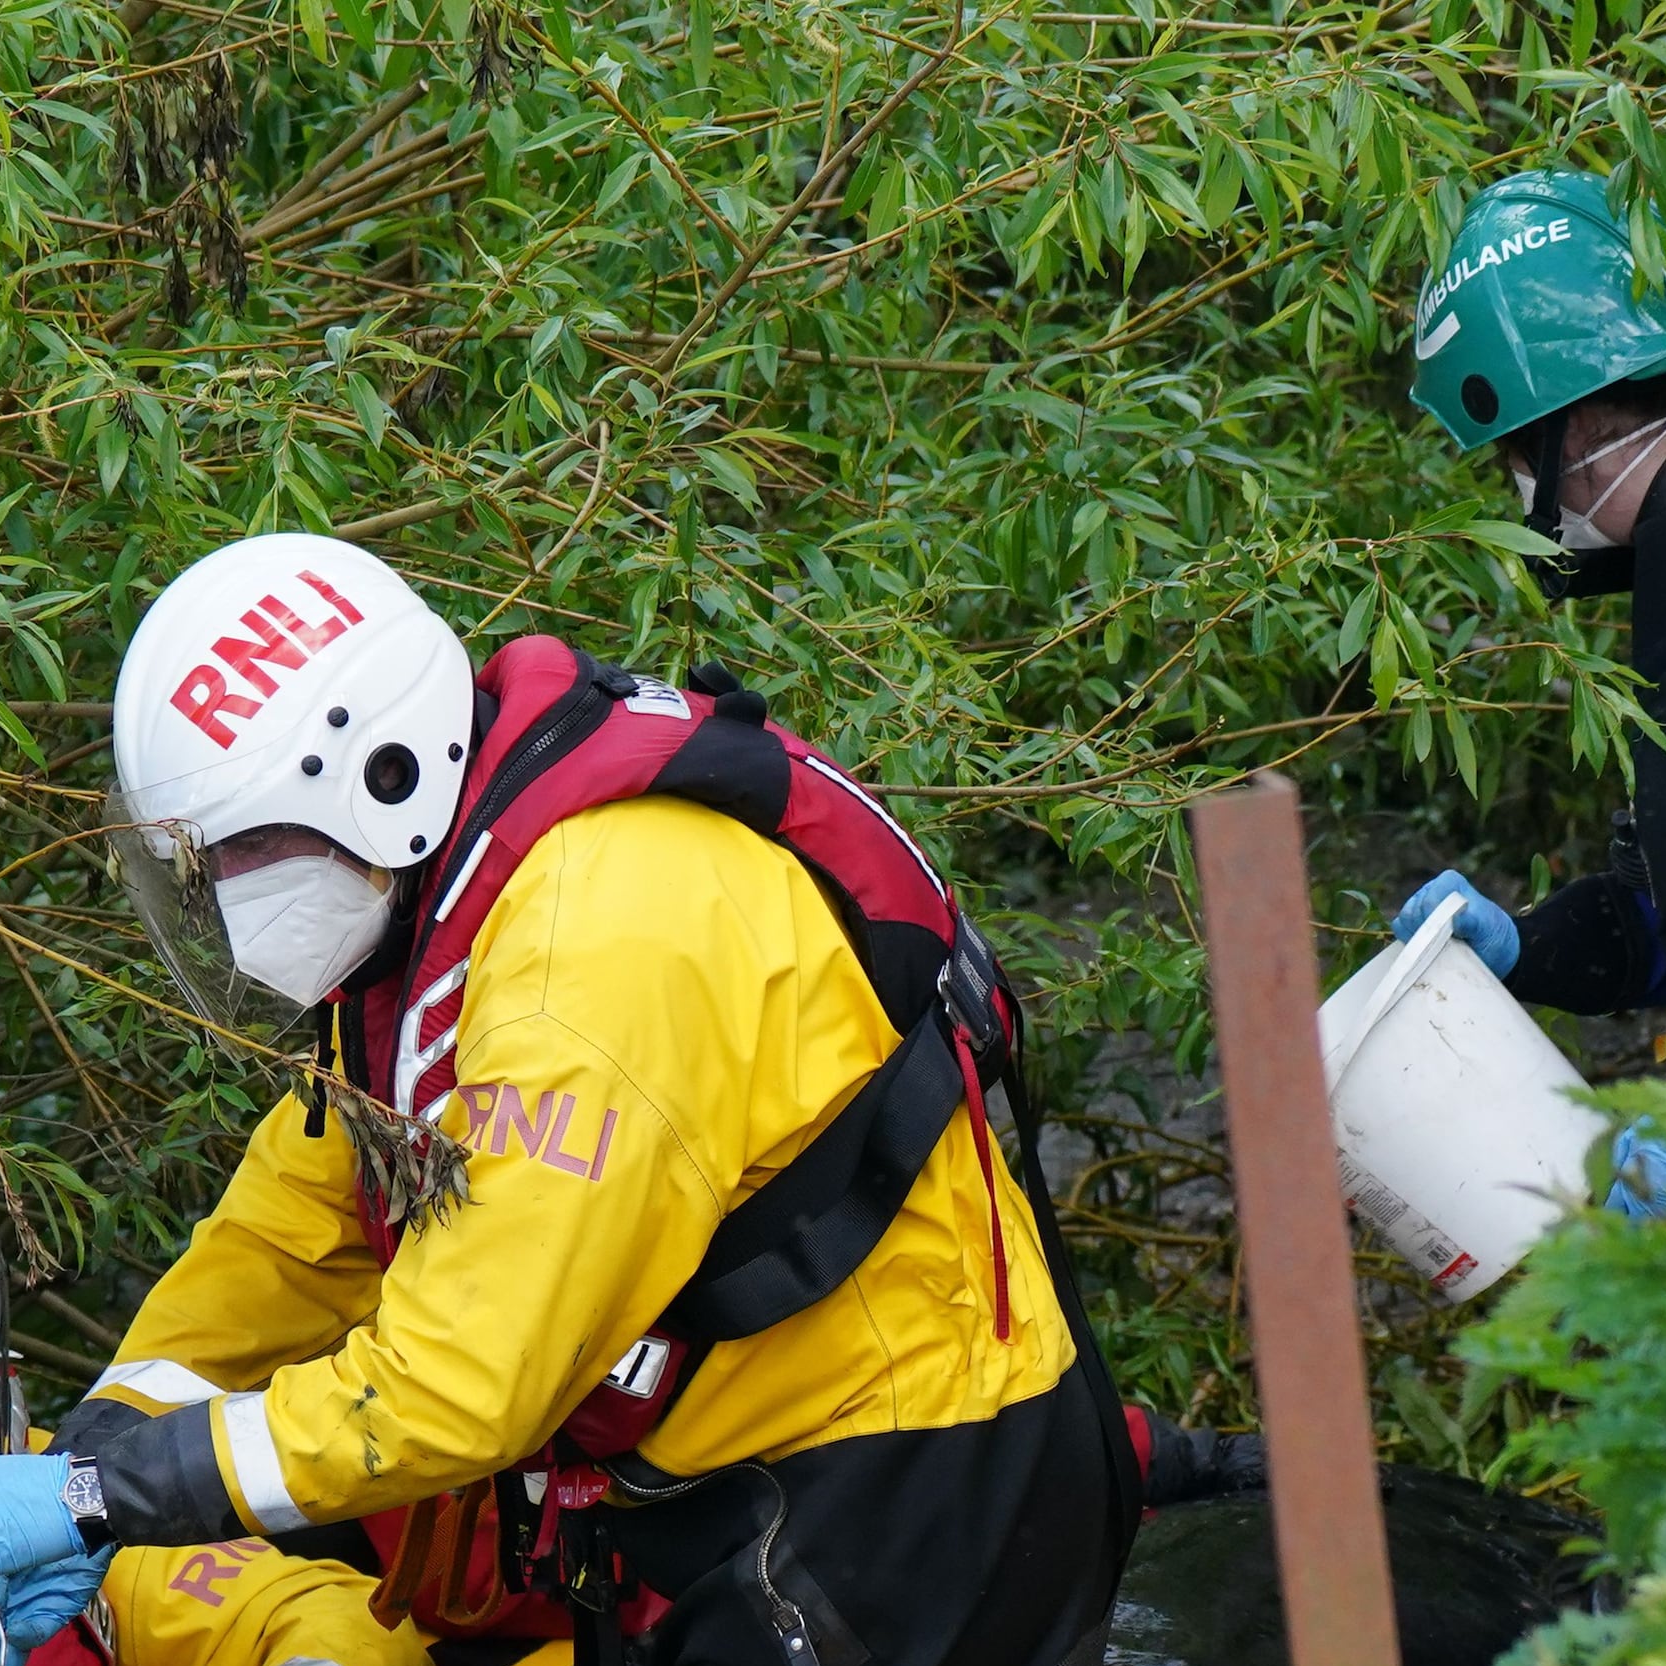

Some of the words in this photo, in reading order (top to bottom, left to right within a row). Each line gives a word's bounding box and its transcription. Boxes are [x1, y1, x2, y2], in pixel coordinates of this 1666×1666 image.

[1419, 218, 1572, 338] AMBULANCE
[171, 569, 366, 751] RNLI
[456, 1083, 619, 1182] RNLI
